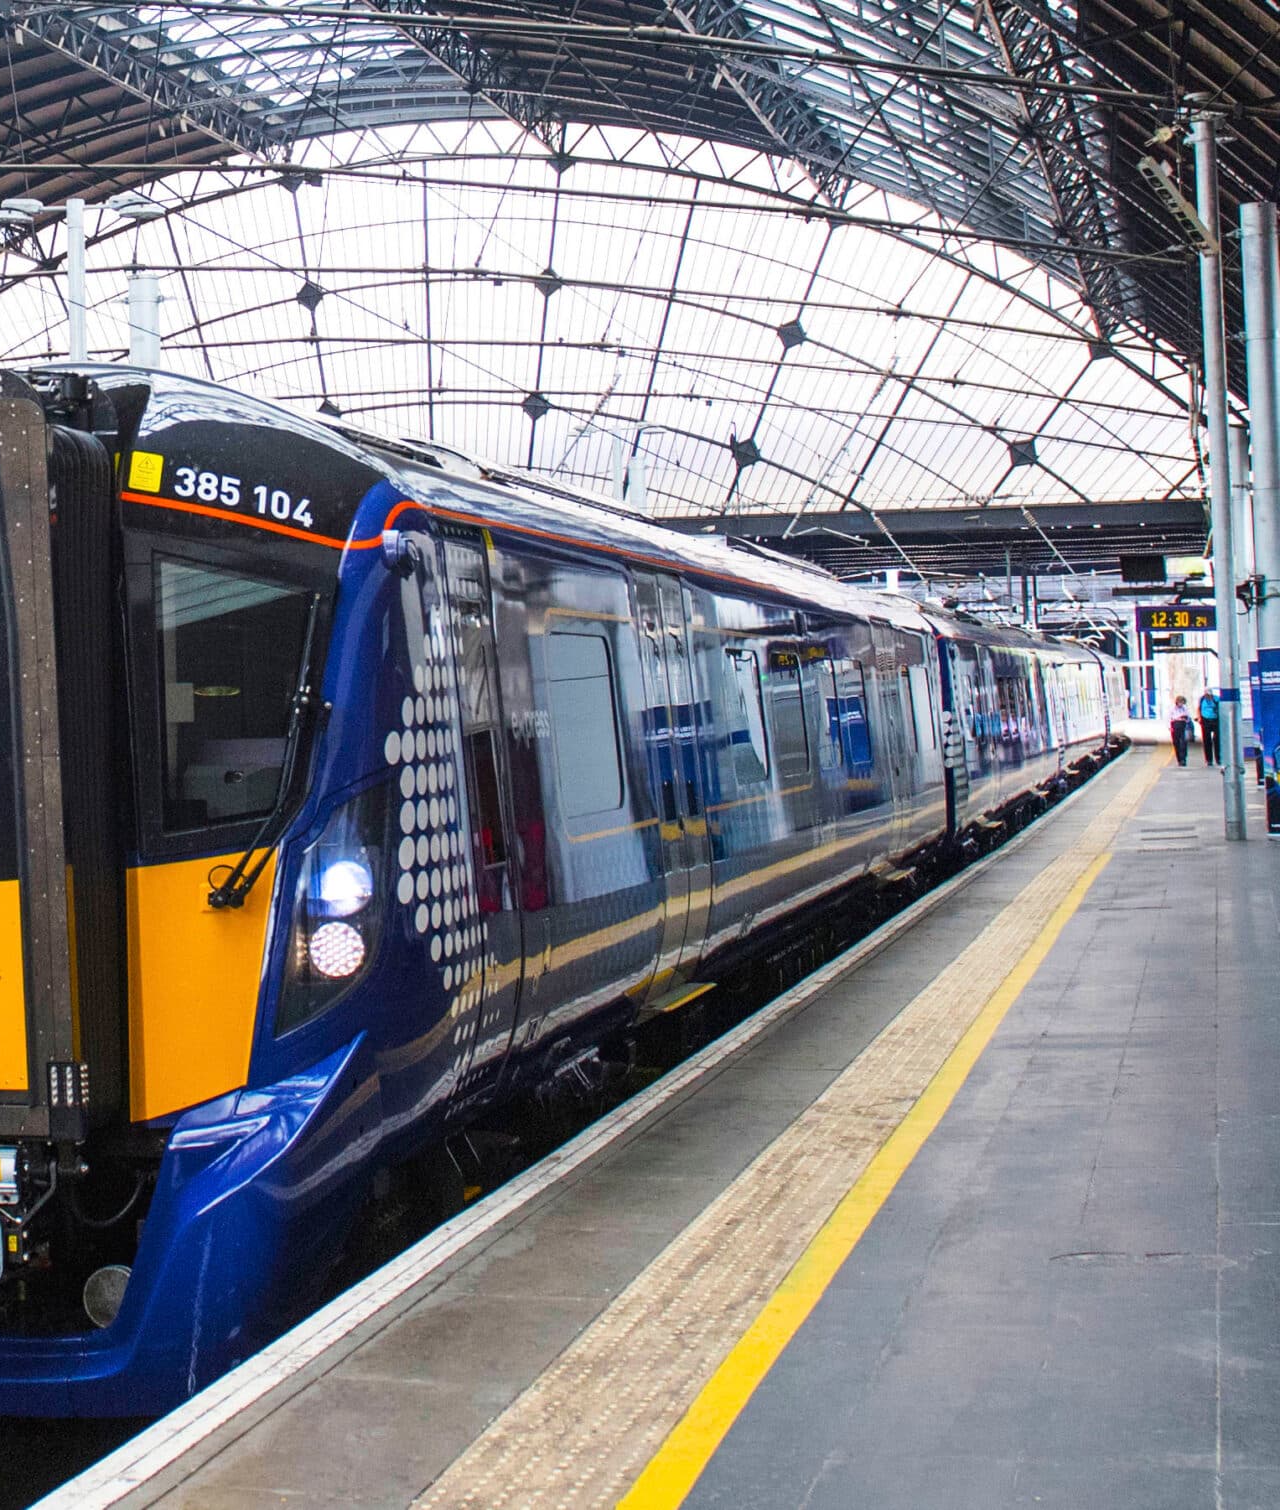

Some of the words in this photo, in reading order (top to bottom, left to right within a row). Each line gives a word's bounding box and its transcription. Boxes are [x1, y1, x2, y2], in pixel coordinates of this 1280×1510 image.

[173, 467, 241, 506] 385
[253, 485, 313, 527] 104
[1151, 611, 1189, 628] 12:30
